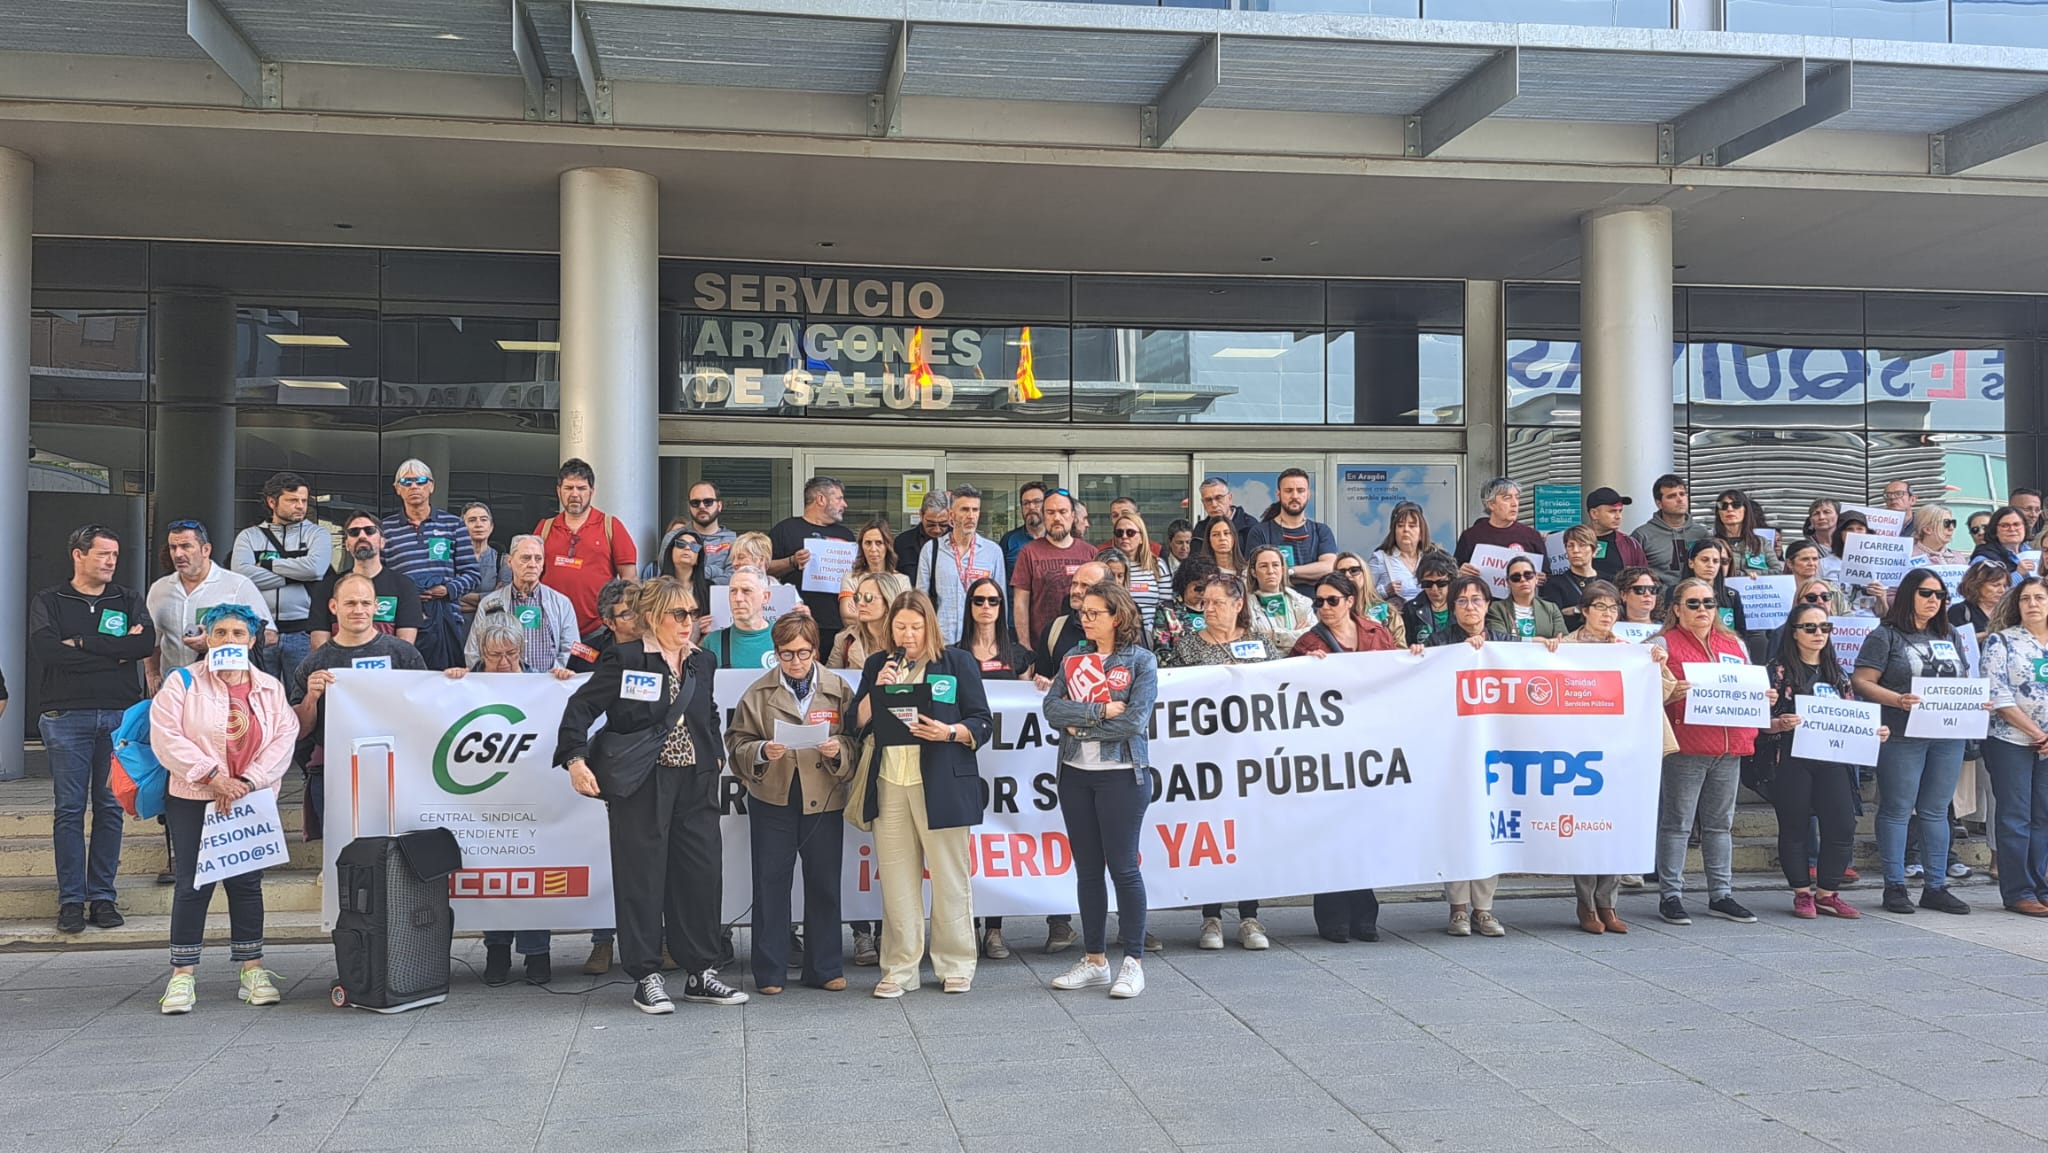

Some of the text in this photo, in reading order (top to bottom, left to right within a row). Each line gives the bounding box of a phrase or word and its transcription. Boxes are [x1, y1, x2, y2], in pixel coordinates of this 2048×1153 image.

[694, 273, 944, 319] SERVICIO
[692, 320, 983, 366] ARAGONES
[694, 367, 954, 410] DE SALUD
[1358, 473, 1385, 481] Aragón
[1859, 541, 1904, 552] ¡CARRERA
[1848, 554, 1906, 566] PROFESIONAL
[1846, 569, 1873, 579] PARA
[213, 647, 242, 659] FTPS
[356, 660, 386, 669] FTPS
[625, 674, 656, 687] FTPS
[1564, 678, 1597, 687] Sanidad
[1461, 676, 1522, 705] UGT
[1564, 689, 1592, 699] Aragón
[1692, 688, 1764, 700] NOSOTR@S NO
[1923, 685, 1983, 696] ¡CATEGORÍAS
[1149, 682, 1344, 740] TEGORÍAS
[1693, 705, 1761, 716] HAY SANIDAD!
[1807, 704, 1870, 720] ¡CATEGORÍAS
[1918, 702, 1985, 711] ACTUALIZADAS
[1943, 717, 1958, 727] YA!
[1802, 720, 1874, 737] ACTUALIZADAS
[453, 732, 537, 764] CSIF
[1829, 739, 1844, 749] YA!
[1237, 747, 1412, 797] PÚBLICA
[1485, 750, 1604, 796] FTPS
[420, 812, 537, 822] CENTRAL SINDICAL
[1531, 819, 1612, 831] TCAE ARAGÓN
[529, 829, 537, 838] Y
[1156, 819, 1238, 868] YA!
[217, 841, 280, 867] TOD@S!
[460, 845, 536, 856] NCIONARIOS
[449, 871, 536, 896] COO
